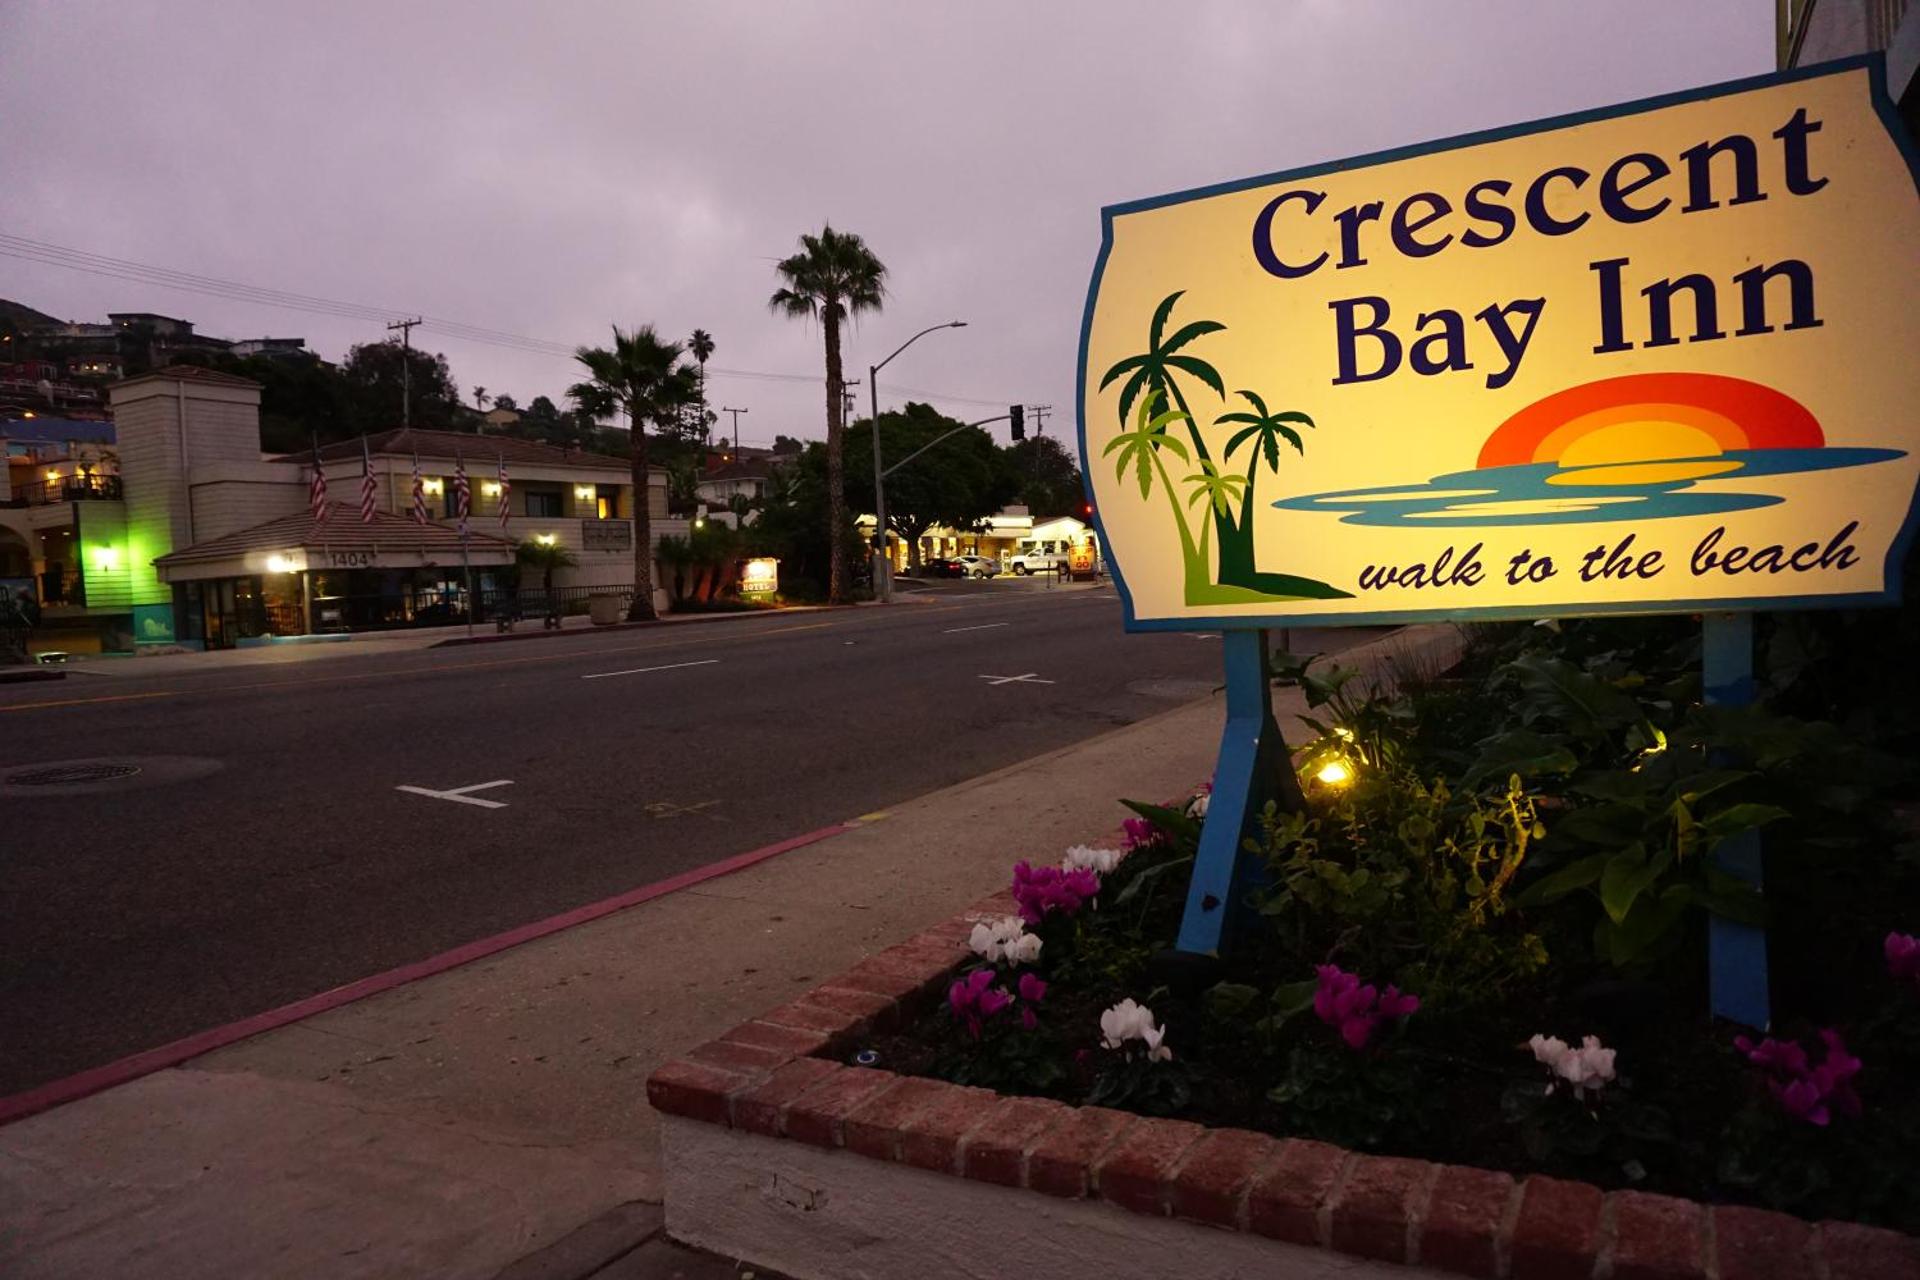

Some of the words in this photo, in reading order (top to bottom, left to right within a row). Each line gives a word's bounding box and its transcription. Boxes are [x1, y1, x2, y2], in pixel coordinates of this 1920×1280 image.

[1252, 107, 1830, 279] Crescent
[1328, 296, 1547, 389] Bay
[1589, 257, 1824, 354] Inn
[332, 552, 367, 567] 1404
[1358, 542, 1486, 590] walk
[1505, 549, 1558, 585] to
[1578, 533, 1666, 582] the
[1691, 520, 1860, 576] beach
